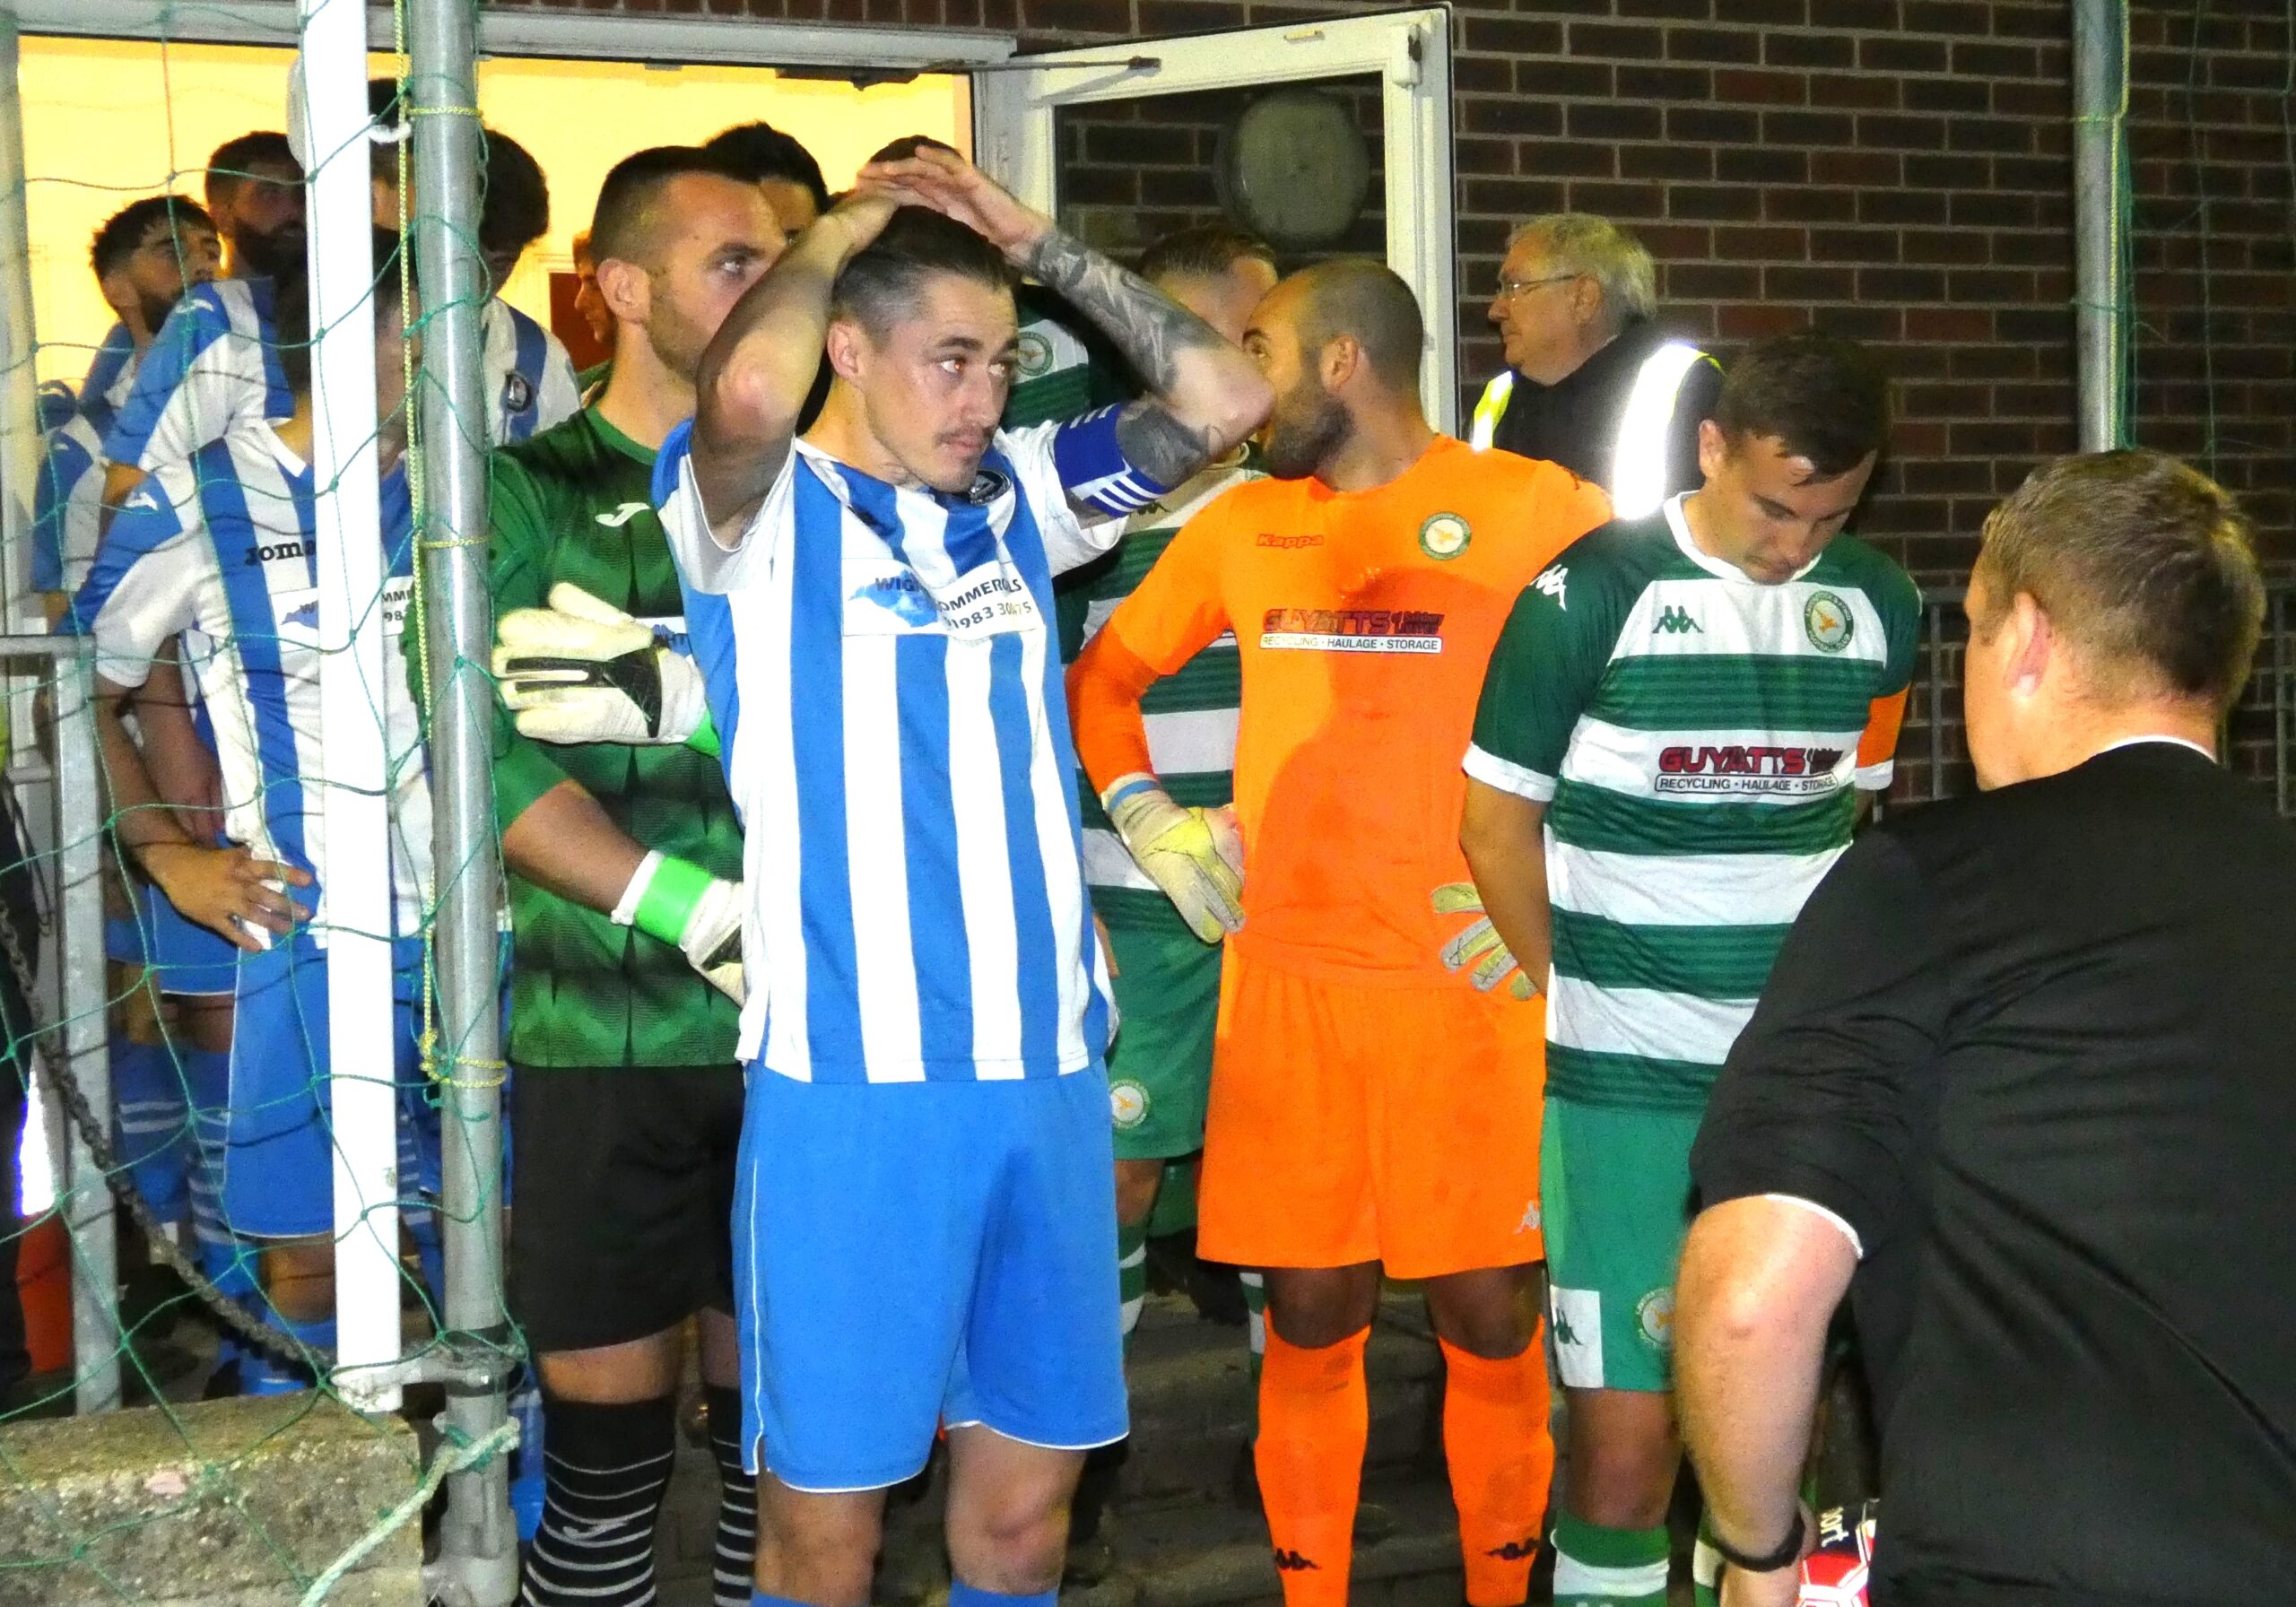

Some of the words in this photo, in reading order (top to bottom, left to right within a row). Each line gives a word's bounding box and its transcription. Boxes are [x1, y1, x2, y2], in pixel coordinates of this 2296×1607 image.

[1256, 534, 1324, 549] Kappa
[1263, 608, 1391, 634] GUYATTS
[1327, 638, 1378, 648] HAULAGE
[1387, 639, 1439, 649] STORAGE
[1659, 746, 1806, 774] GUYATTS
[1659, 777, 1731, 789] RECYCLING
[1742, 778, 1791, 790] HAULAGE
